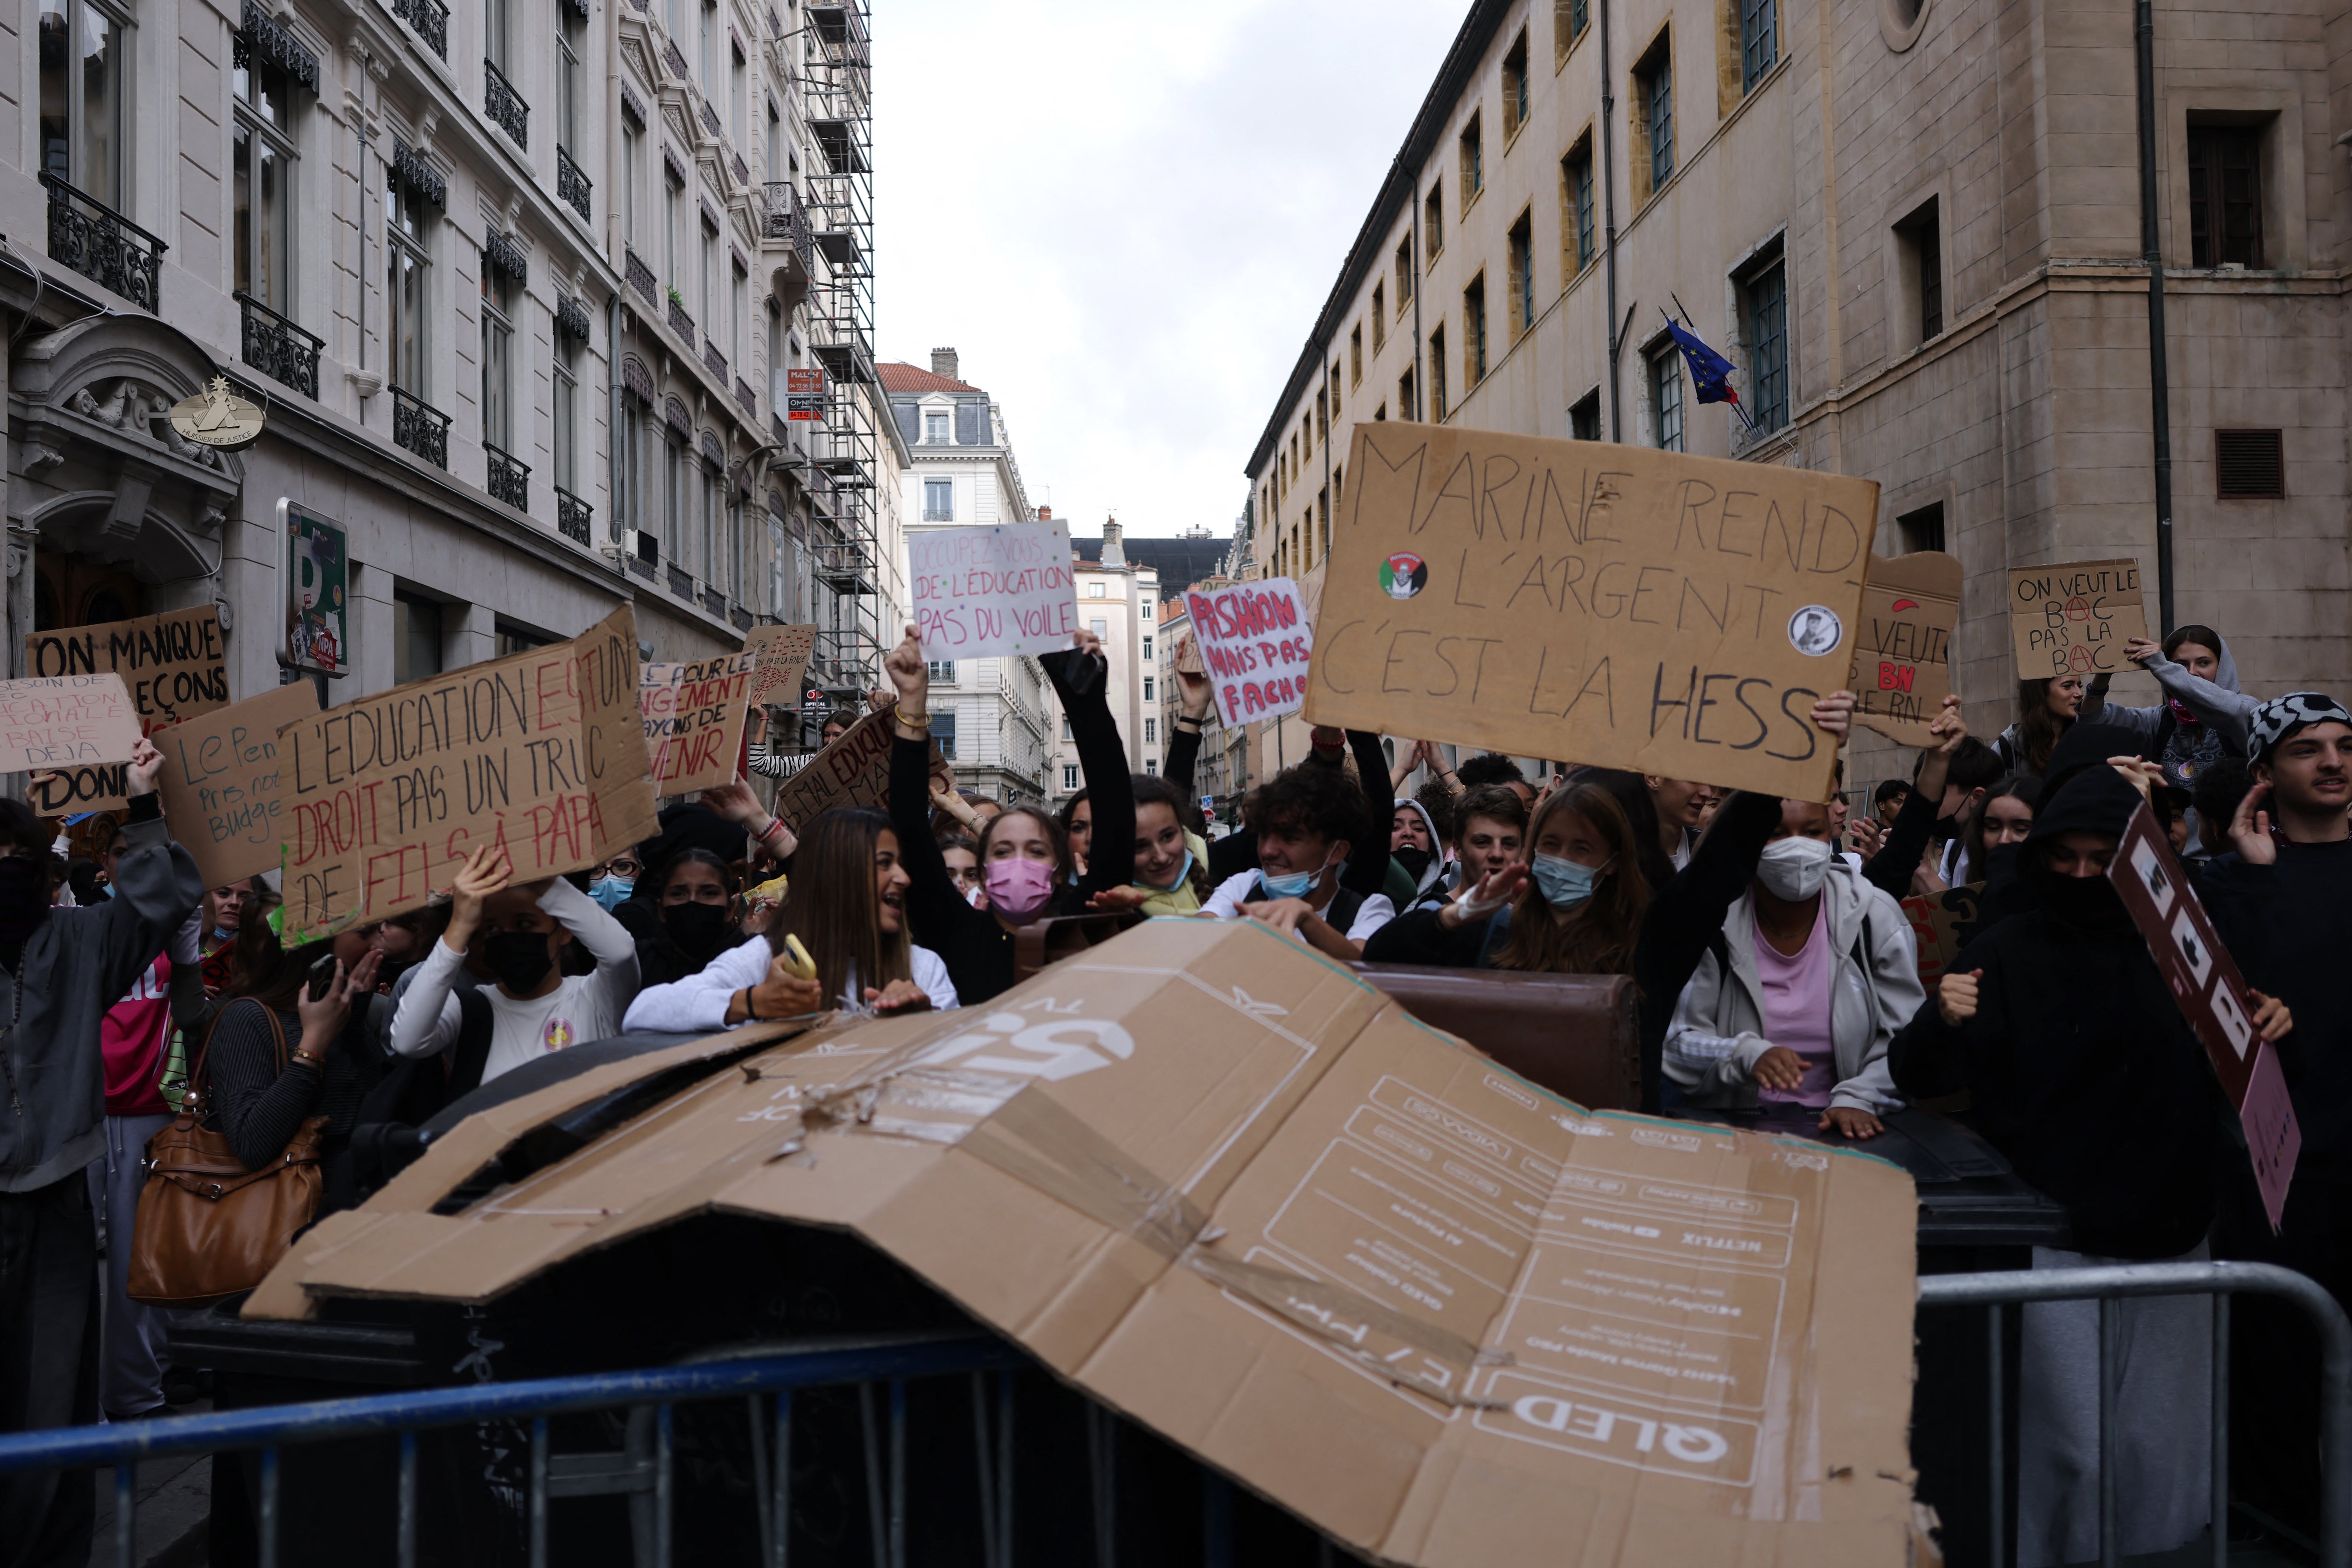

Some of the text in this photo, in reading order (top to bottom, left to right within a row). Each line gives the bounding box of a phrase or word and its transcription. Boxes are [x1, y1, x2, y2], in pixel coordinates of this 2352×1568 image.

[182, 429, 211, 443] HUISSIER
[226, 430, 252, 443] JUSTICE
[1354, 433, 1860, 573] MARINE REND
[916, 565, 1074, 599] DE L'ÉDUCATION
[1454, 548, 1783, 639] L'ARGENT
[2018, 569, 2137, 601] ON VEUT LE
[919, 601, 1075, 646] PAS DU VOILE
[1189, 589, 1296, 641] FASHION
[2045, 595, 2114, 628] BAC
[36, 618, 222, 677] ON MANQUE
[319, 637, 333, 656] NPA
[1873, 618, 1947, 664] VEUT
[2030, 622, 2112, 650] PAS LA
[671, 658, 724, 686] POUR
[727, 652, 754, 674] LE
[789, 655, 807, 665] FORCE
[1206, 637, 1310, 677] MAIS PAS
[2052, 644, 2115, 675] BAC
[72, 675, 107, 687] DE
[134, 666, 229, 721] EÇONS
[1321, 619, 1820, 761] C'EST LA HESS
[1879, 662, 1915, 693] BN
[294, 626, 631, 794] L'EDUCATION EST UN
[699, 704, 726, 727] DE
[1889, 692, 1922, 724] RN
[6, 725, 100, 748] BAISE
[232, 727, 276, 767] Pen
[292, 724, 605, 867] DROIT PAS UN TRUC
[793, 771, 839, 814] MAL
[296, 864, 346, 924] DE
[524, 790, 607, 868] PAPA
[1018, 996, 1084, 1014] TV
[1582, 1217, 1762, 1253] NETFLIX YouTube
[1668, 1297, 1717, 1314] Dolby
[1513, 1395, 1728, 1463] QLED
